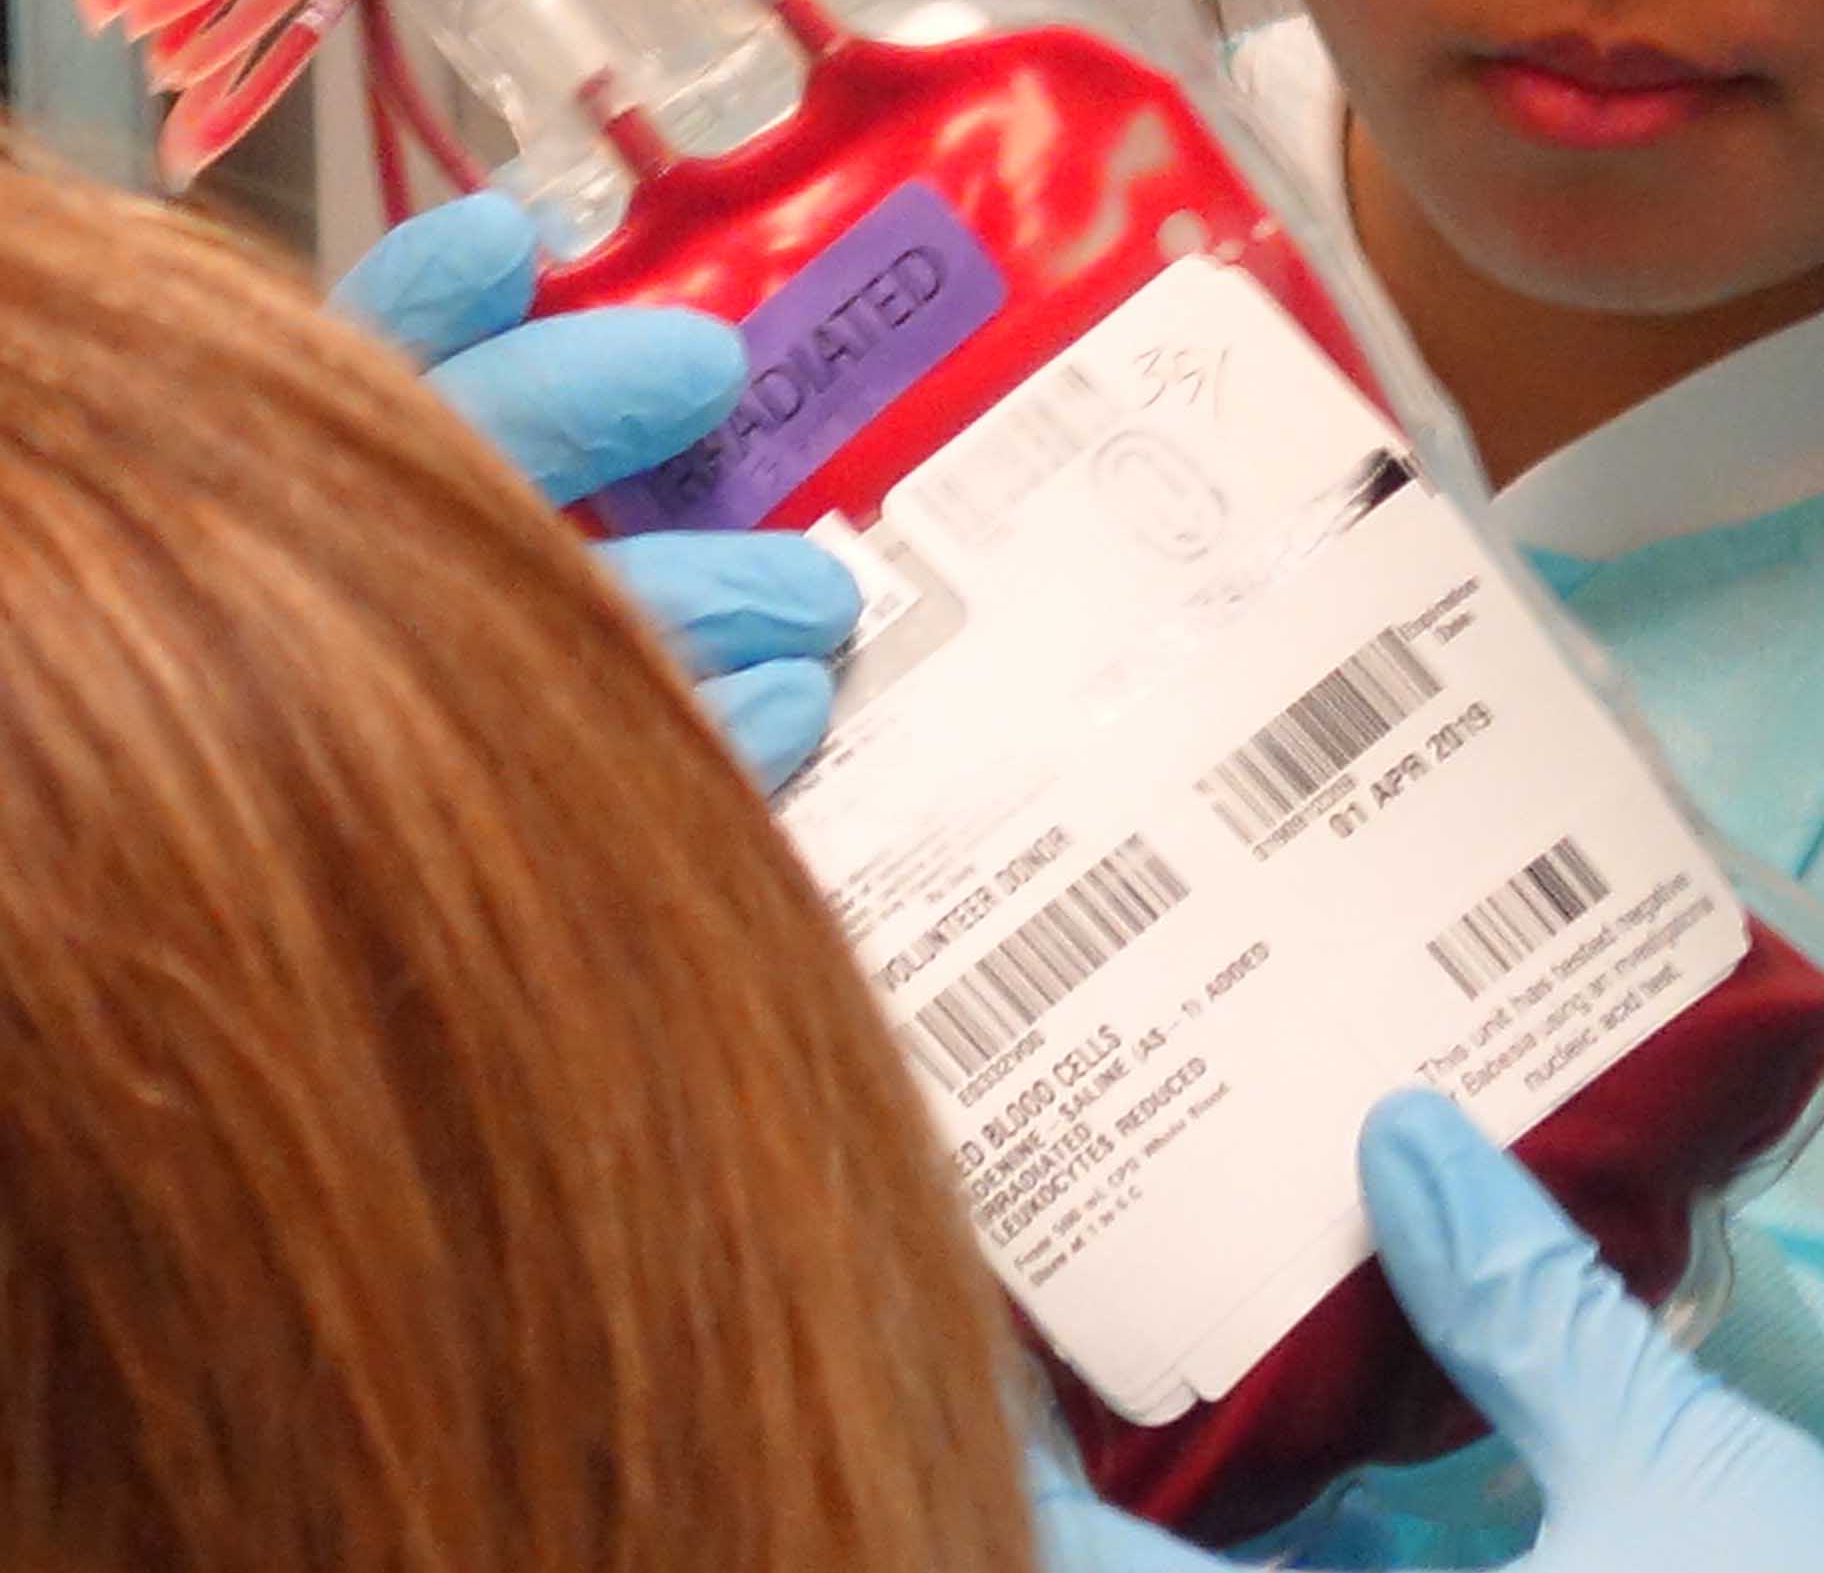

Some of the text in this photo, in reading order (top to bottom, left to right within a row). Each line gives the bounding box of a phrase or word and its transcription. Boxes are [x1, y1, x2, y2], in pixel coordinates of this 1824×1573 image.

[1329, 701, 1495, 839] 01 APR 2019
[873, 884, 998, 992] VOLUNTEER
[994, 824, 1074, 895] DONOR
[971, 1129, 1047, 1199] DENINE
[1059, 1057, 1130, 1120] SALINE
[1205, 940, 1270, 1001] ADDED
[982, 1079, 1056, 1150] BLOOD
[1053, 1024, 1121, 1087] CELLS
[990, 1057, 1207, 1247] LEUKOCYTES REDUCED
